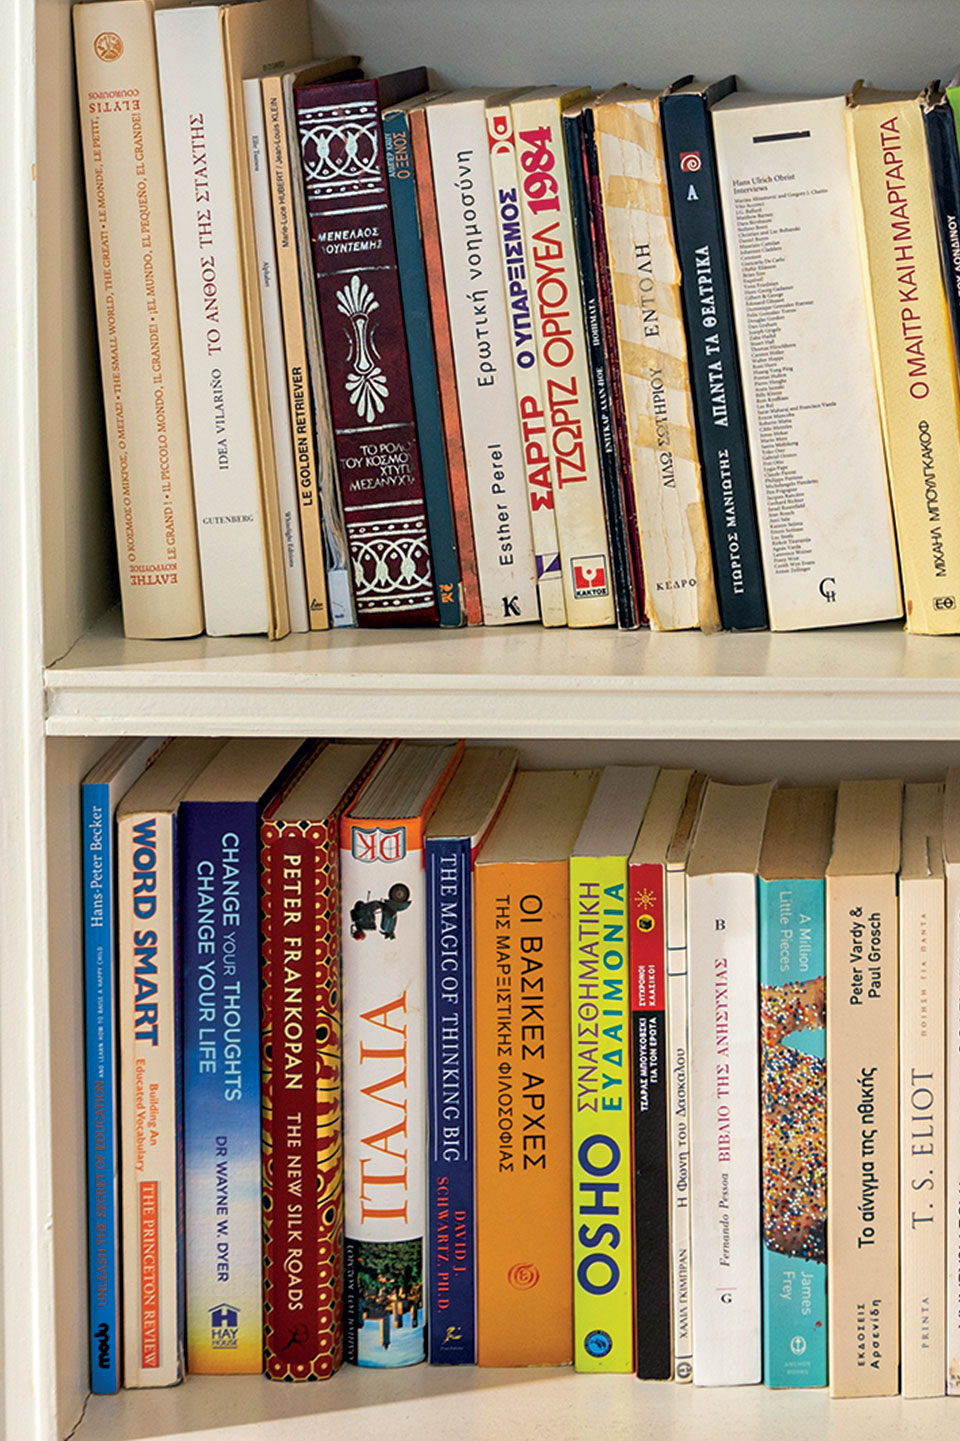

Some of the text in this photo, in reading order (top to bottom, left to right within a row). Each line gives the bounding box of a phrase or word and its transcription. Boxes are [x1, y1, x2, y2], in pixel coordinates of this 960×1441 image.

[453, 150, 496, 387] Ερωτική νοημοσύνη
[518, 126, 587, 490] ΤΖΩΡΤΖ ΟΡΓΟΥΕΛ 1984
[635, 244, 660, 337] ΕΝΤΟΛΗ
[202, 513, 254, 526] GUTENBERG
[487, 444, 514, 565] Esther Perel
[519, 396, 554, 511] ΣΑΡΤΡ
[695, 245, 744, 594] ΓΙΩΡΓΟΣ ΜΑΝΙΩΤΗΣ ΑΠΑΝΤΑ ΤΑ ΘΕΑΤΡΙΚΑ
[918, 420, 946, 577] ΜΙΧΑΗΛ ΜΠΟΥΛΓΚΑΚΟΦ
[88, 805, 104, 928] Hans-Peter Becker
[132, 818, 158, 1046] WORD SMART
[196, 860, 216, 1074] CHANGE YOUR LIFE
[222, 832, 242, 1102] CHANGE YOUR THOUGHTS
[867, 912, 881, 998] Paul Grosch
[283, 854, 303, 1090] PETER FRANKOPAN
[440, 854, 460, 1162] THE MAGIC OF THINKING BIG
[495, 894, 514, 1173] ΤΗΣ ΜΑΡΞΙΣΤΙΚΗΣ ΦΙΛΟΣΟΦΙΑΣ
[519, 894, 545, 1171] ΟΙ ΒΑΣΙΚΕΣ ΑΡΧΕΣ
[576, 882, 600, 1113] ΣΥΝΑΙΣΘΗΜΑΤΙΚΗ
[602, 883, 624, 1112] ΕΥΔΑΙΜΟΝΙΑ
[714, 958, 731, 1162] ΒΙΒΛΙΟ ΤΗΣ ΑΝΗΣΥΧΙΑΣ
[359, 990, 408, 1224] ΙΤΑΛΙΑ
[856, 1068, 879, 1249] Το αίνιγμα της ηθικής
[142, 1183, 158, 1368] THE PRINCETON REVIEW
[283, 1112, 303, 1311] THE NEW SILK ROADS
[577, 1134, 621, 1296] OSHO
[718, 1172, 730, 1267] Fernando Pessoa
[780, 1270, 794, 1300] Frey
[800, 1270, 814, 1316] James
